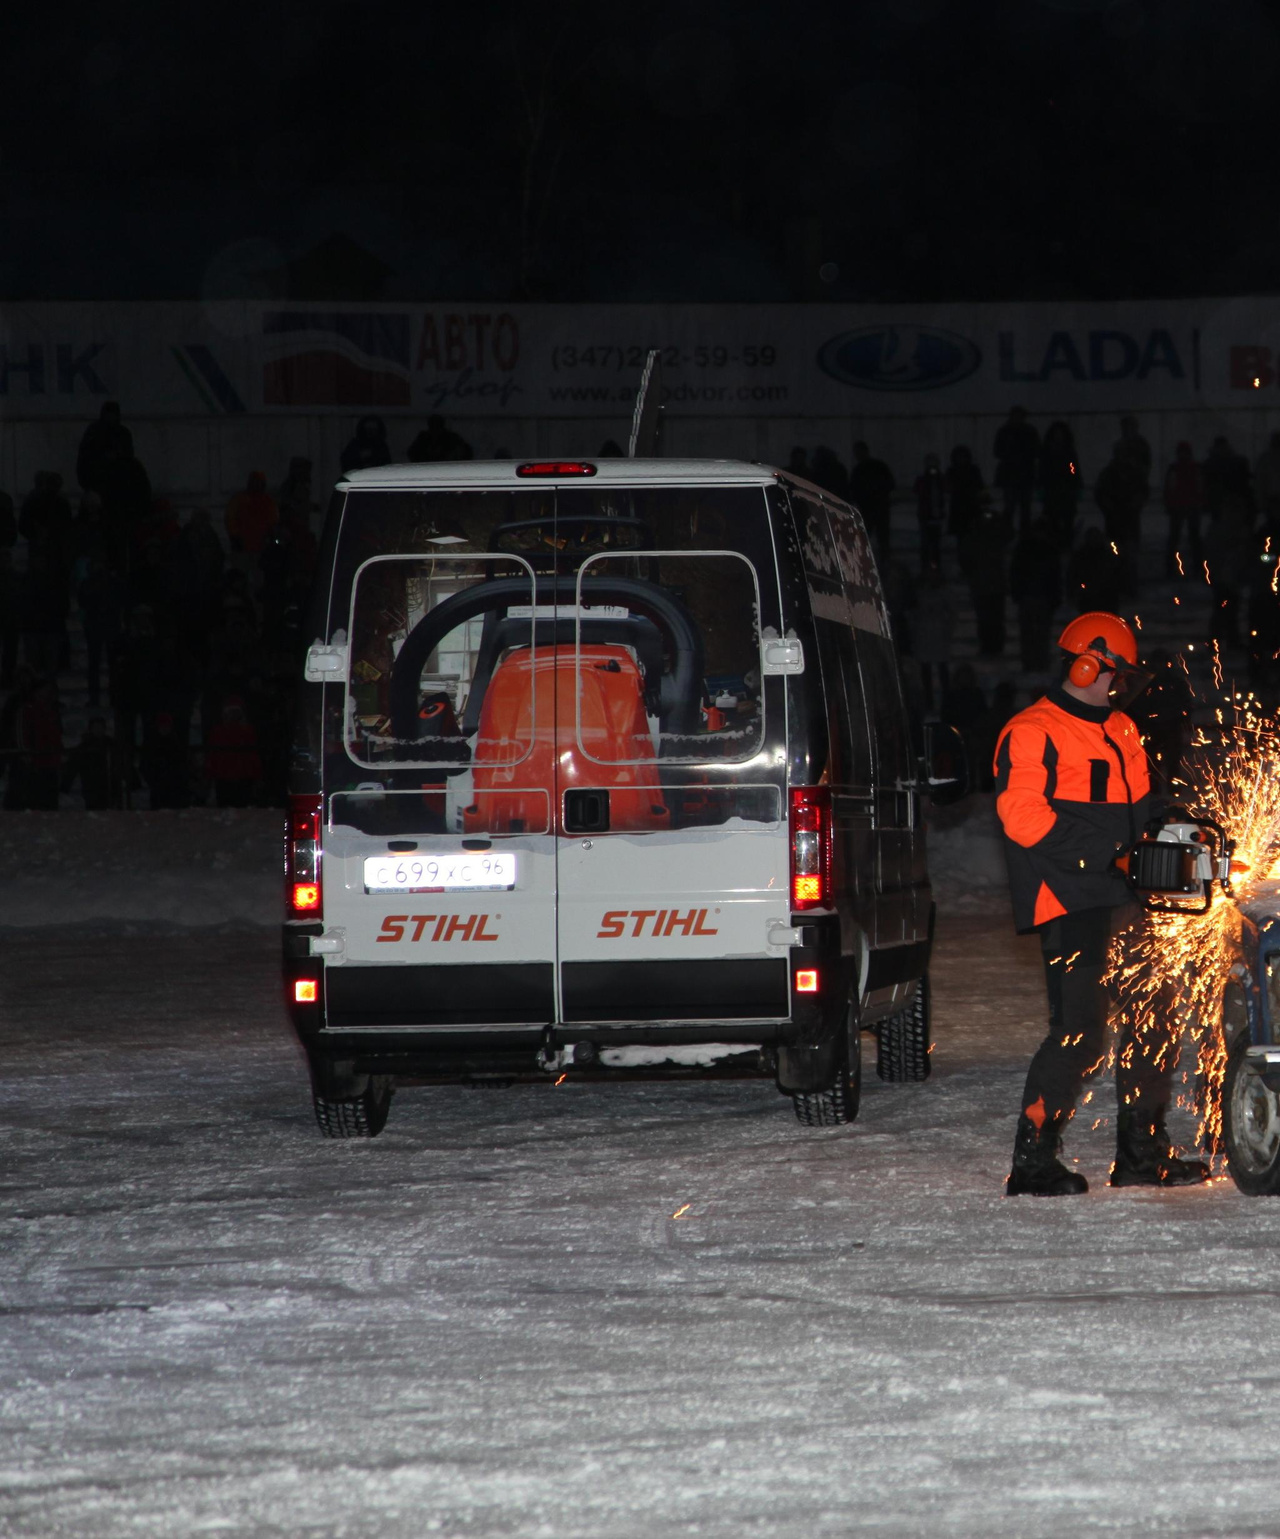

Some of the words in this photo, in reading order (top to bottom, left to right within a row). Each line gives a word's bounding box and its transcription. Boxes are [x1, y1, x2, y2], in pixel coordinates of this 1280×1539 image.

[416, 312, 520, 371] АВТО
[999, 328, 1186, 382] LADA
[551, 345, 777, 371] (347)22-59-59
[548, 382, 789, 402] www.aodvor.com
[375, 913, 499, 943] STIHL
[597, 908, 720, 939] STIHL
